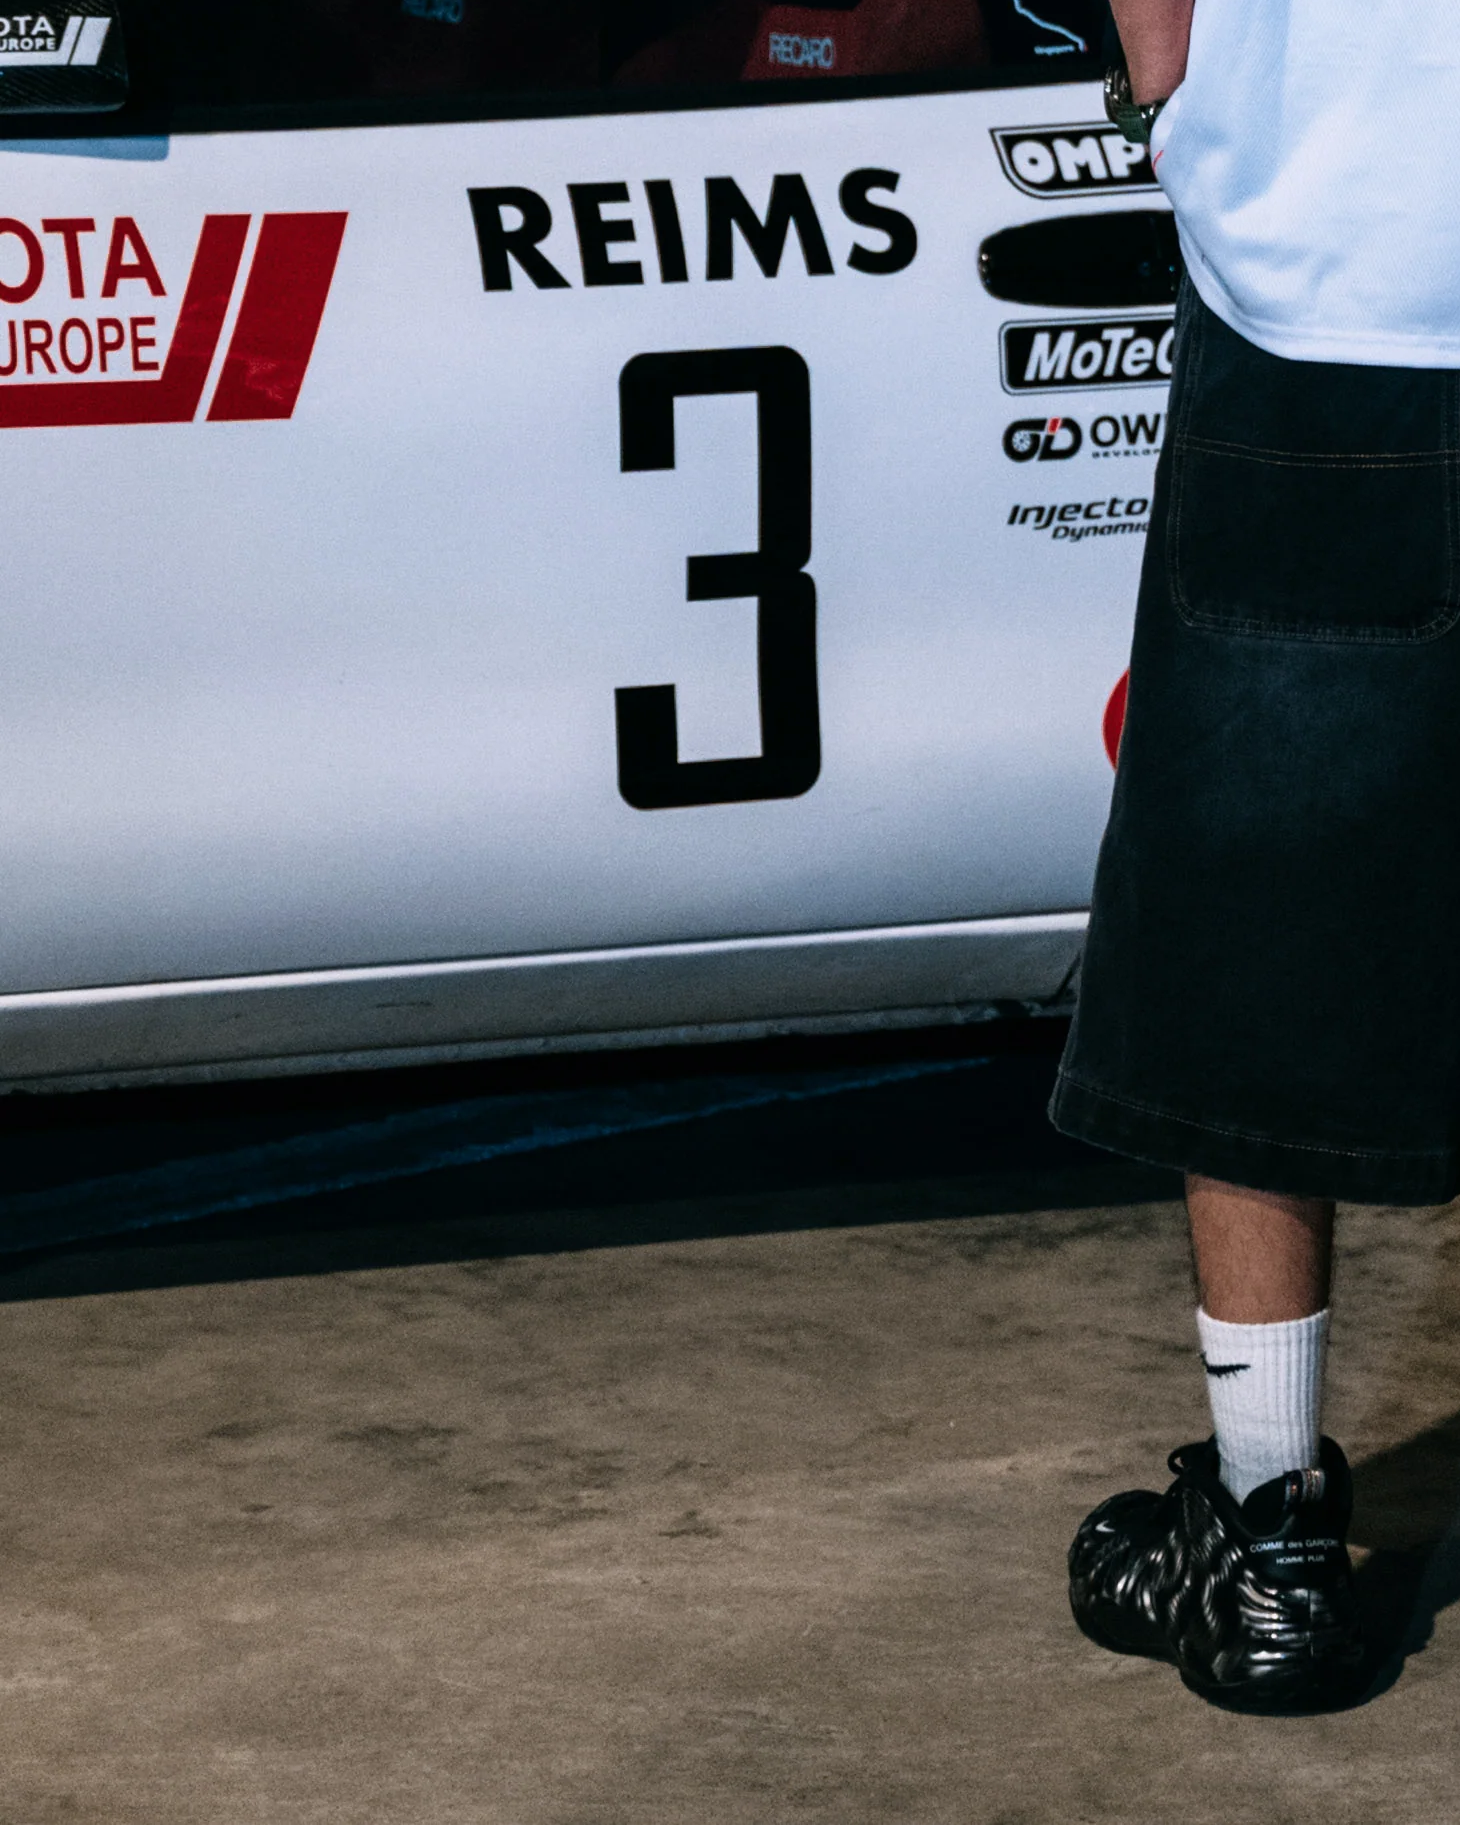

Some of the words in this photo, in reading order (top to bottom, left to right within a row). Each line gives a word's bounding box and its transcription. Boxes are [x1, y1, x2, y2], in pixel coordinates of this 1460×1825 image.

[768, 32, 835, 69] RECARO
[1011, 134, 1146, 184] OMP
[466, 167, 918, 292] REIMS
[0, 217, 167, 304] OTA
[1090, 413, 1168, 448] OW
[614, 345, 821, 811] 3
[1249, 1540, 1285, 1554] COMME
